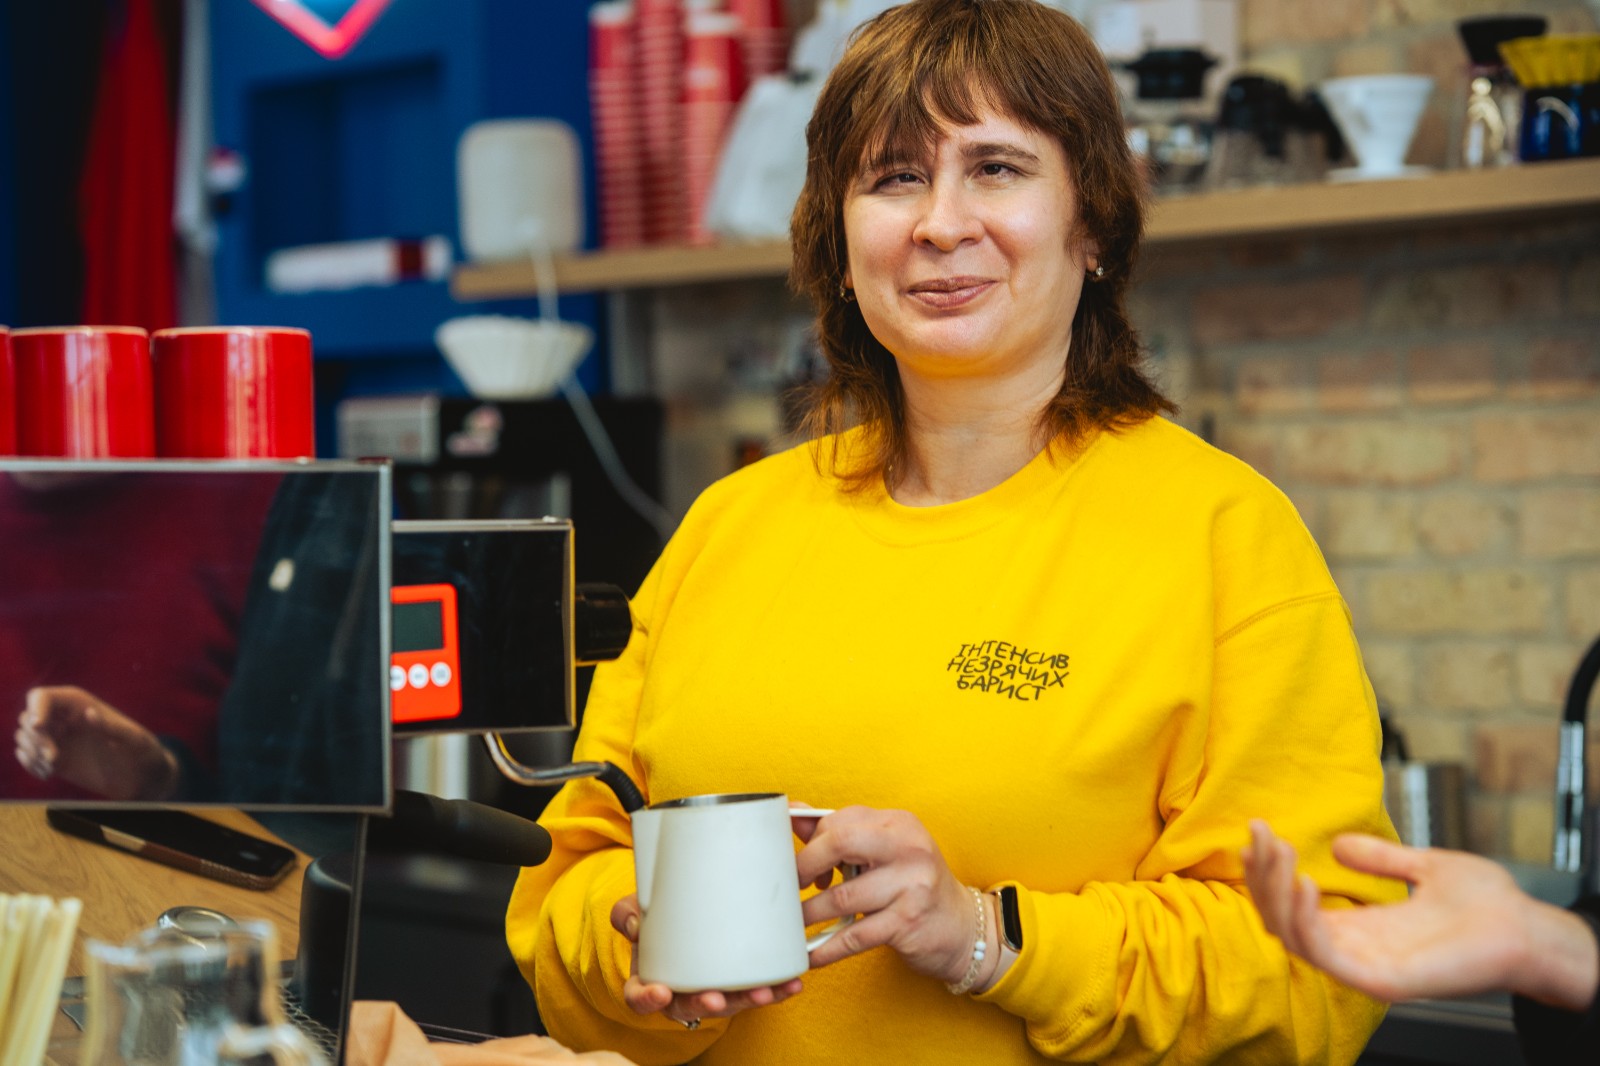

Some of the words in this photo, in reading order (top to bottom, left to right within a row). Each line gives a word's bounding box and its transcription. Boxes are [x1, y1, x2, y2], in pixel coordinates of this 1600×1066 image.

[956, 640, 1070, 669] ІНТЕНСИВ
[947, 656, 1069, 688] НЕЗРЯЧИХ
[956, 675, 1046, 701] БАРИСТ
